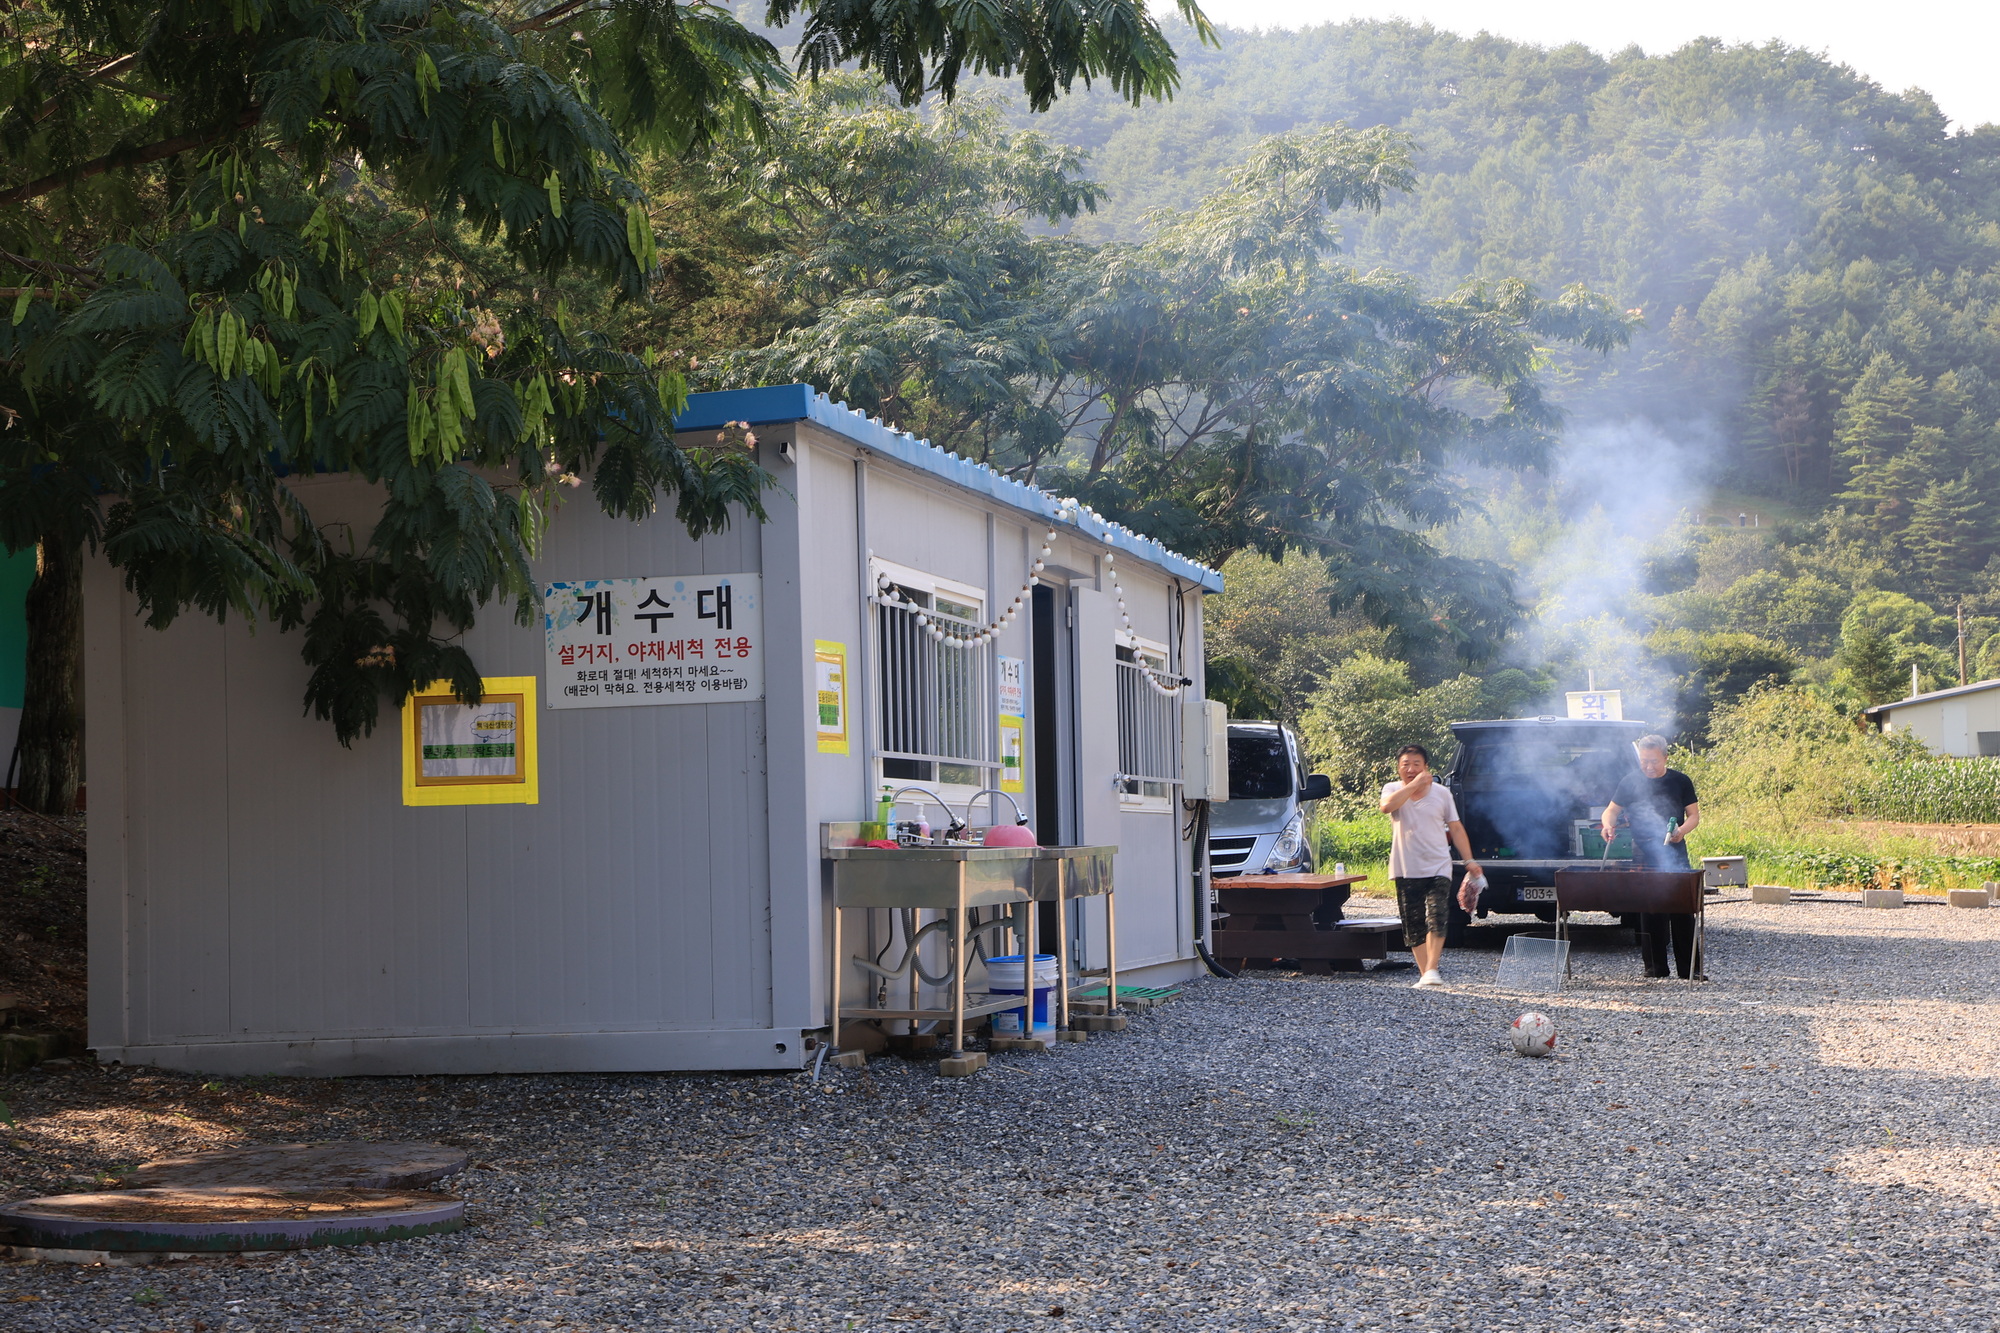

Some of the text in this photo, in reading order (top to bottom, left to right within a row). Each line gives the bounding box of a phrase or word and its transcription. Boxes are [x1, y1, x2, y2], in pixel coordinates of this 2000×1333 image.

[558, 637, 752, 665] 설거지, 야채세척 전용
[577, 669, 608, 682] 화로대
[613, 668, 636, 681] 절대!
[641, 667, 683, 680] 세척하지
[564, 679, 748, 697] (배관이 막혀요. 전용세척장 이용바람)
